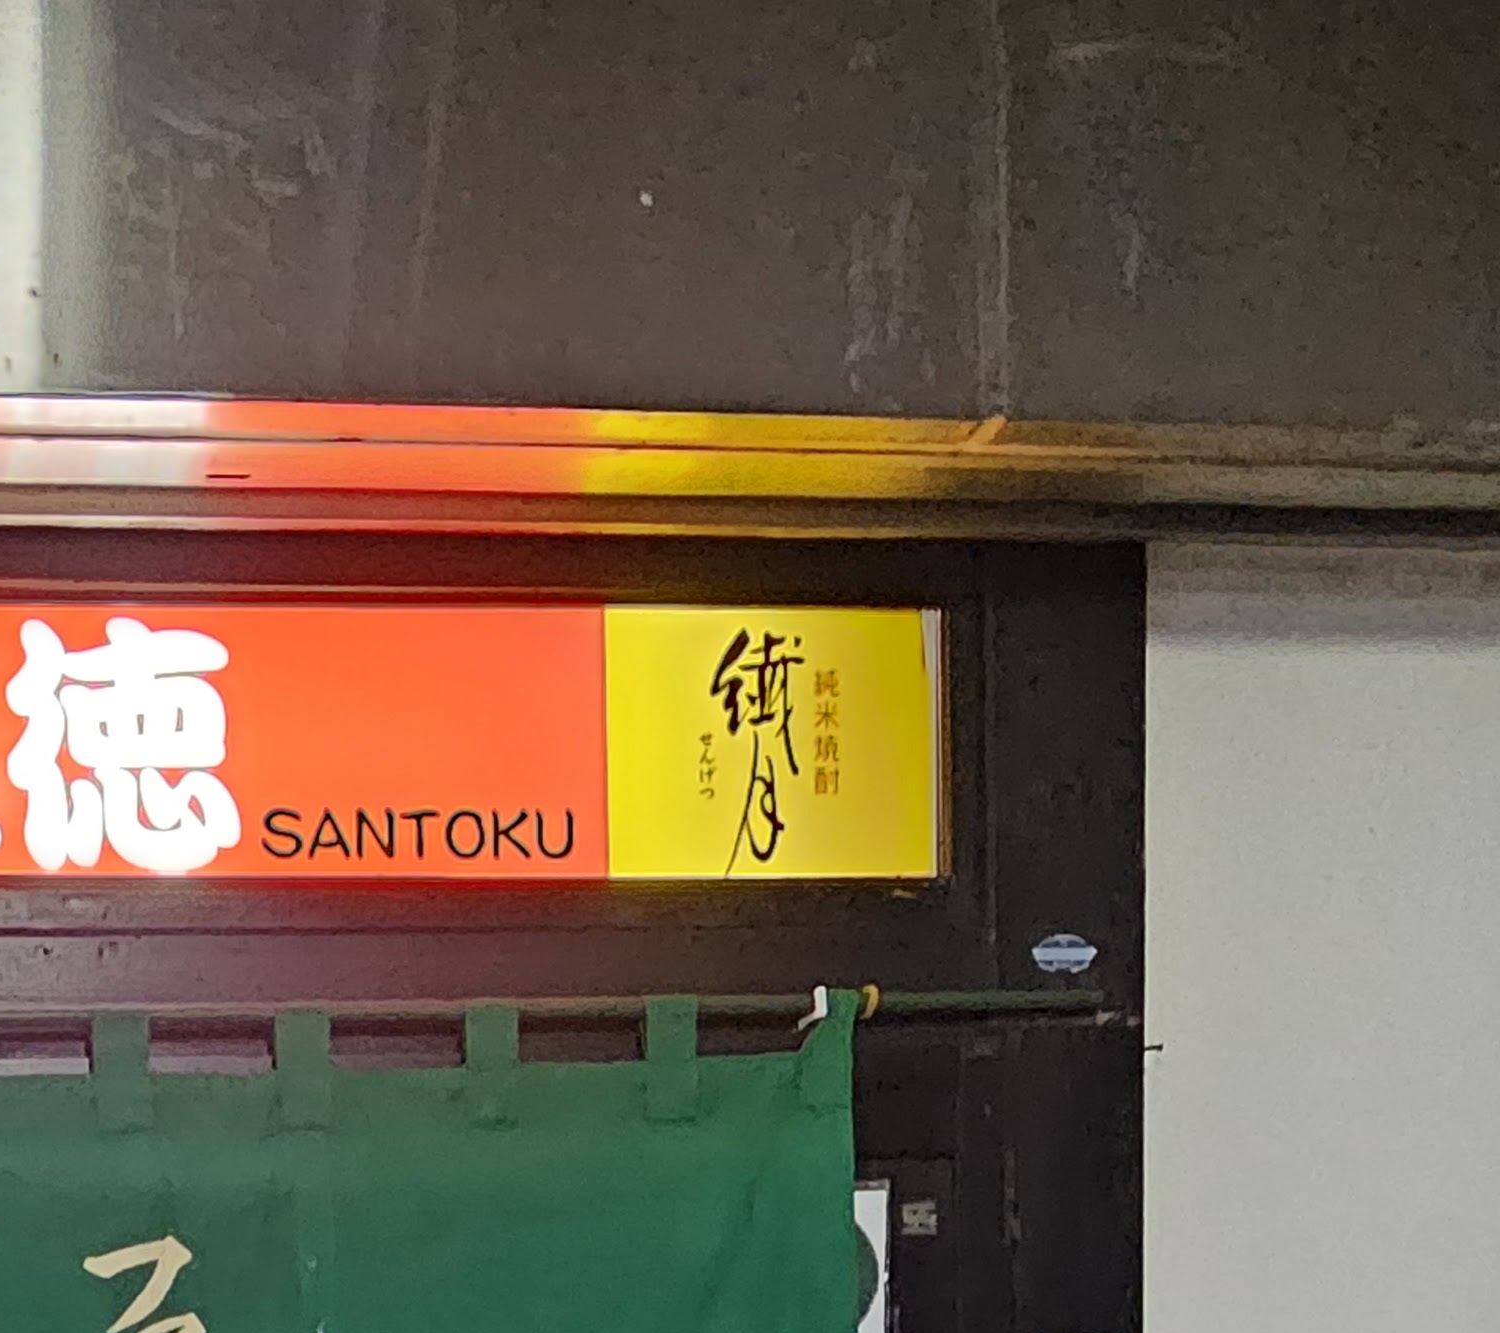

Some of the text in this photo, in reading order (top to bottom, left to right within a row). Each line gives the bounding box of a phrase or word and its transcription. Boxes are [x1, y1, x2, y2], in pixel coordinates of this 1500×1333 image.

[698, 732, 716, 800] せんげつ
[814, 669, 840, 796] 純米焼酎
[263, 807, 576, 860] SANTOKU
